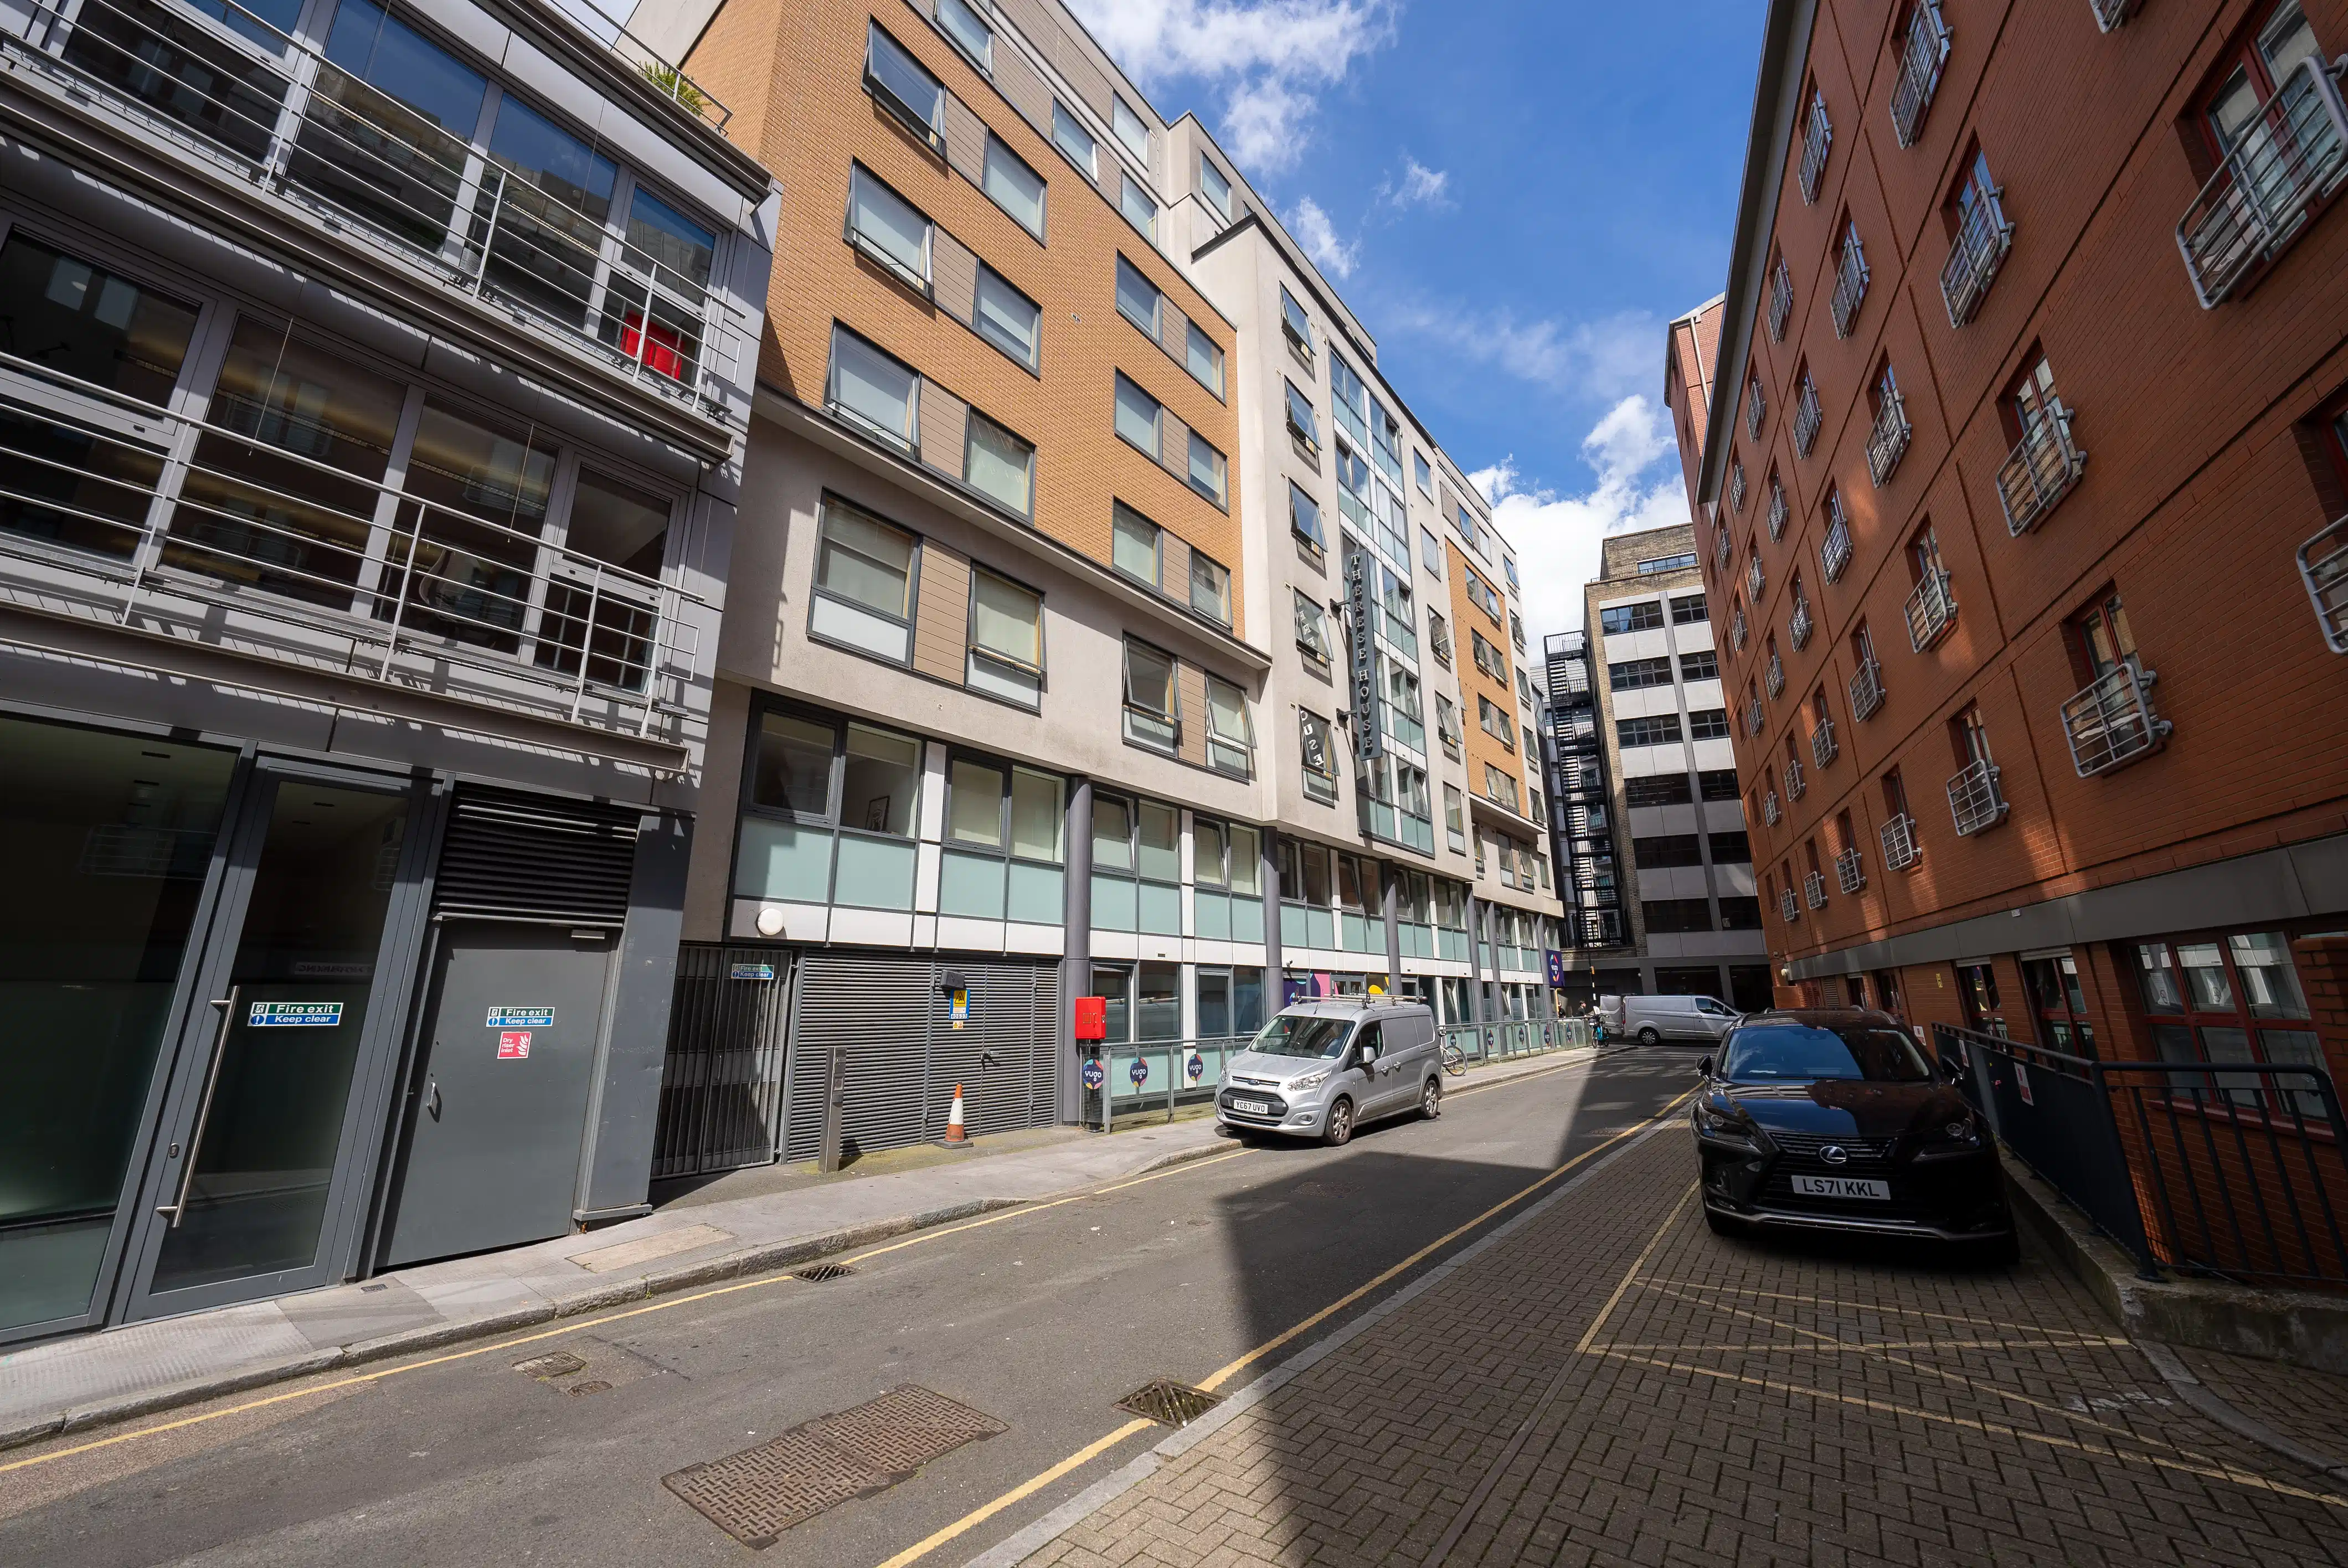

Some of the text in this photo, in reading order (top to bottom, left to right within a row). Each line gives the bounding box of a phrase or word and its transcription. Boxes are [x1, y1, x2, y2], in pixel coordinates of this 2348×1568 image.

[1350, 554, 1373, 749] THERESE HOUSE
[276, 1004, 334, 1013] Fire exit
[275, 1015, 302, 1024] Keep
[1131, 1069, 1146, 1079] yugo
[1190, 1065, 1202, 1074] yugo
[1085, 1070, 1102, 1082] yugo
[1236, 1101, 1265, 1112] YC67 UVO
[1803, 1178, 1880, 1197] LS71 KKL
